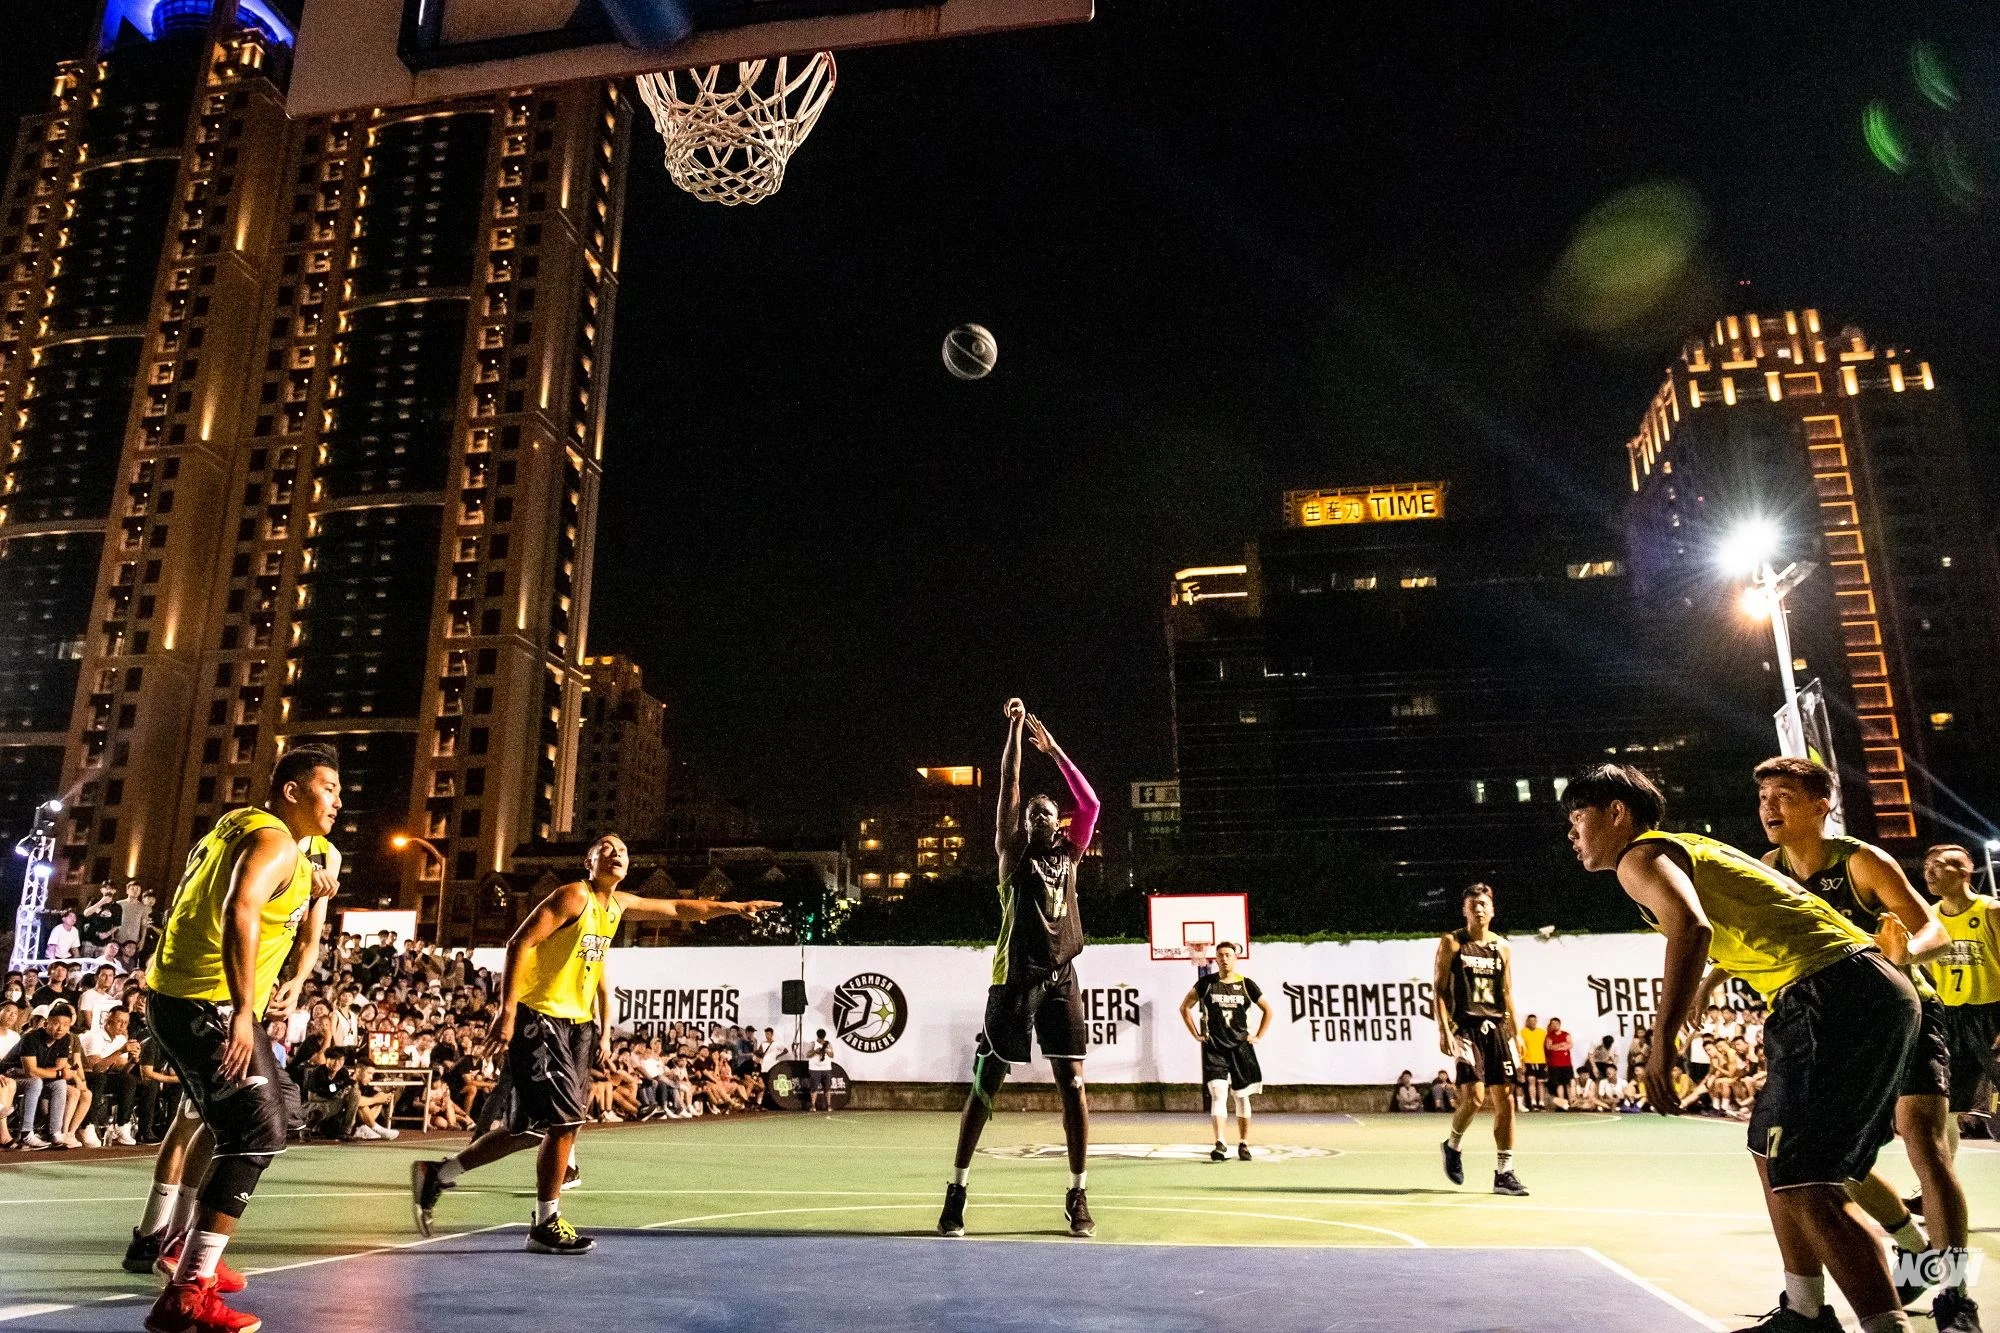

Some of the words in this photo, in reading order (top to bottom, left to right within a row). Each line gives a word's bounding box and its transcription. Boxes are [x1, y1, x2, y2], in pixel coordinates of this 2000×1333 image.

[1370, 494, 1435, 518] TIME
[849, 975, 893, 991] FORMOSA
[1951, 969, 1963, 992] 7
[614, 985, 740, 1024] DREAMERS
[1282, 981, 1435, 1023] DREAMERS
[1309, 1018, 1412, 1042] FORMOSA
[845, 1033, 896, 1052] DREAMERS
[1769, 1126, 1783, 1158] 7
